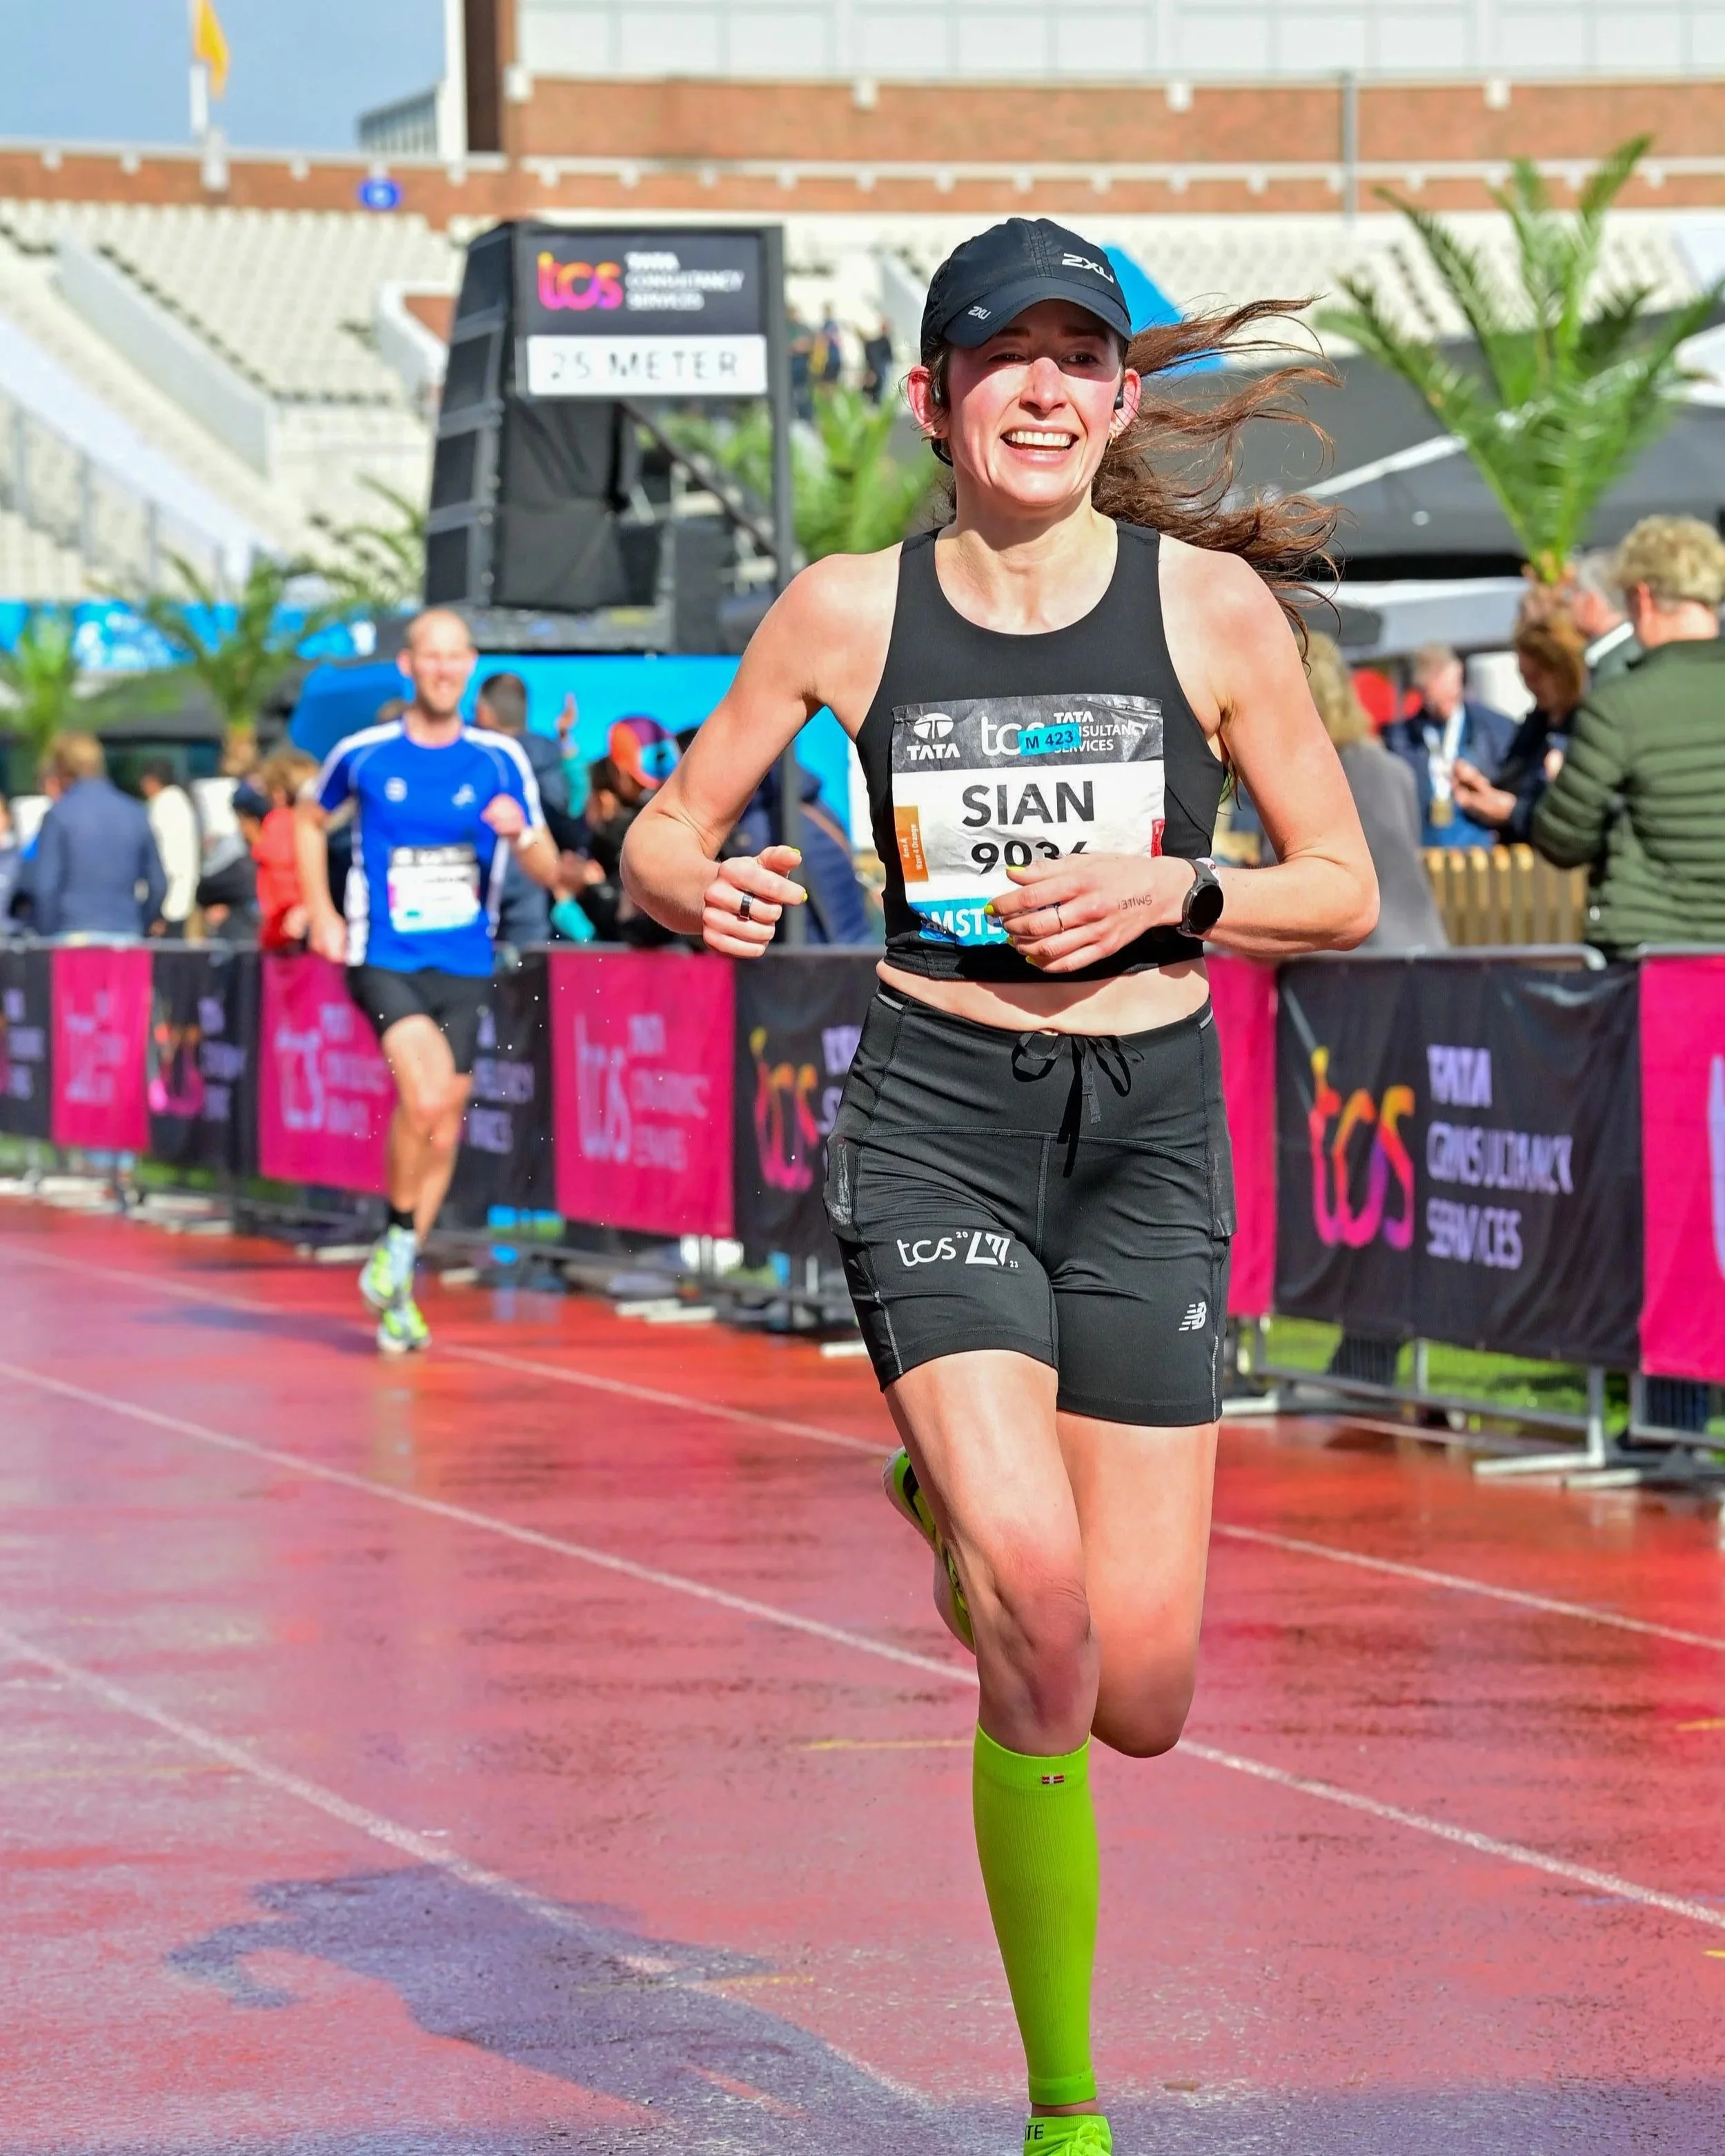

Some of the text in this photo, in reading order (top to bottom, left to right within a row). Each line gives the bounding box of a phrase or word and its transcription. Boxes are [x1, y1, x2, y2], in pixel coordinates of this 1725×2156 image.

[968, 306, 992, 320] 2XU
[551, 350, 738, 380] 25 METER
[1053, 711, 1094, 724] TATA
[1025, 730, 1074, 750] M 423
[906, 742, 961, 760] TATA
[962, 780, 1095, 827] SIAN
[911, 824, 919, 849] Orange
[915, 854, 923, 871] Wave
[897, 1237, 956, 1267] tcs
[1009, 1260, 1019, 1269] 23
